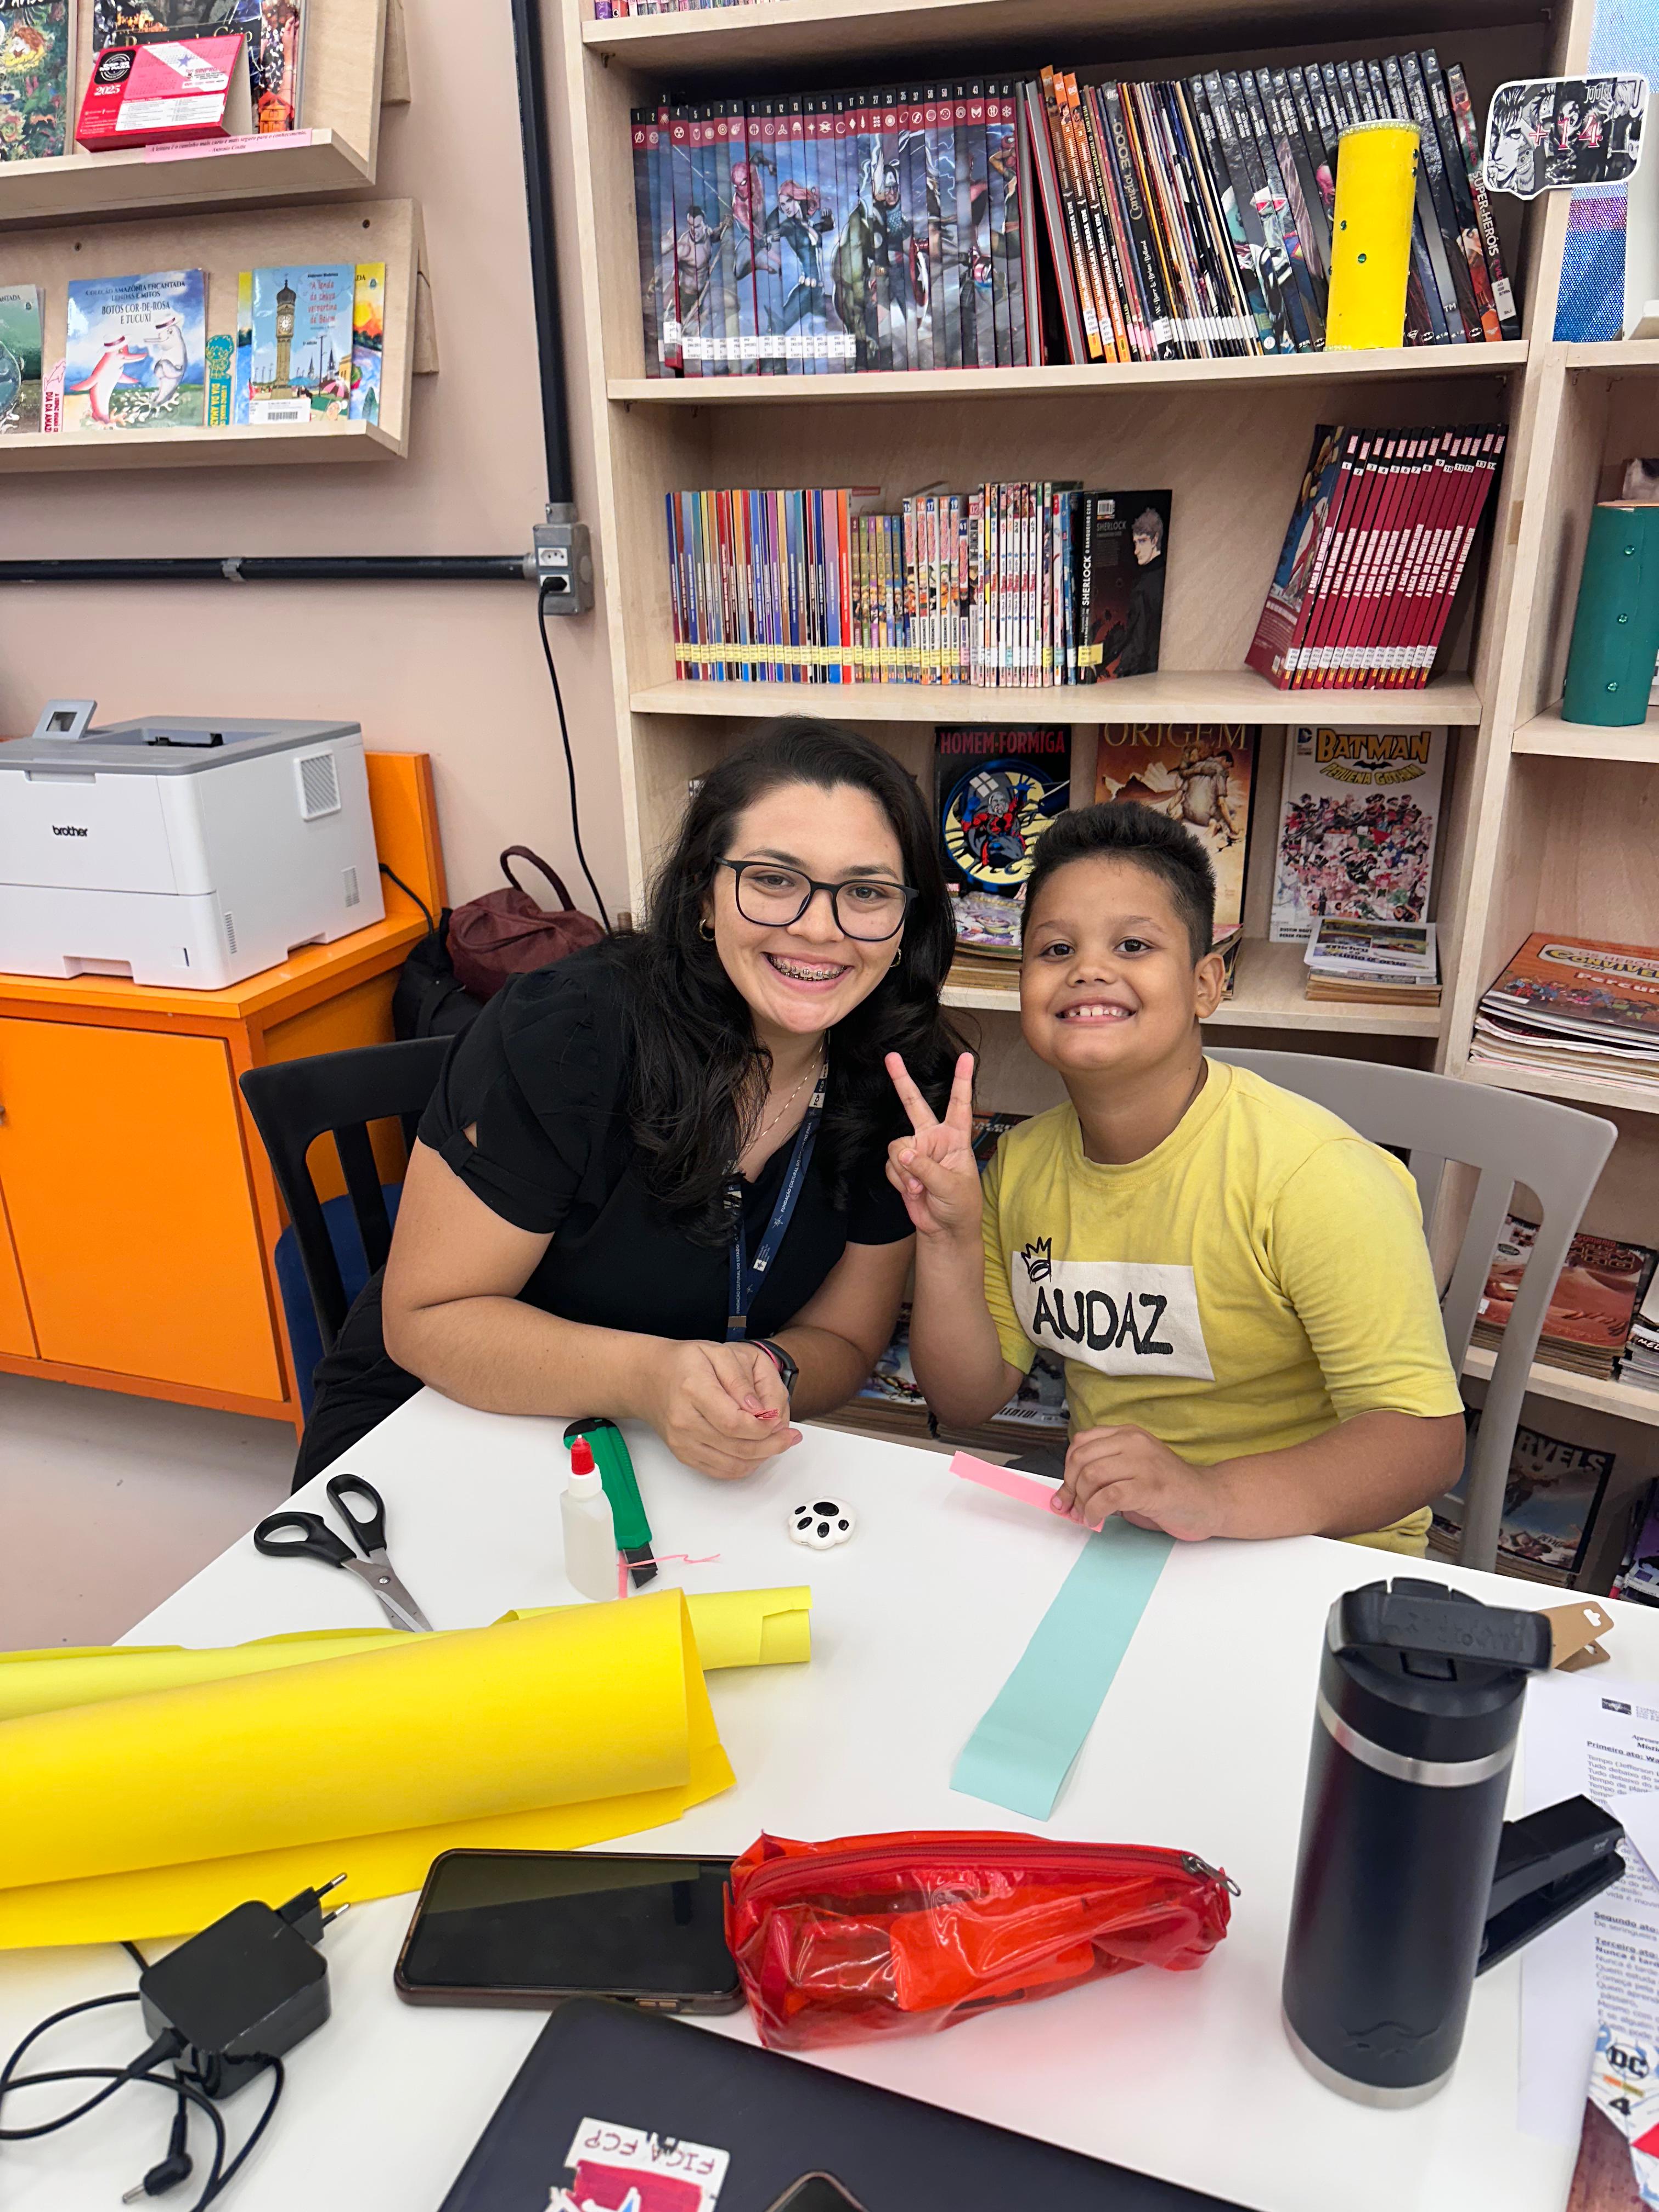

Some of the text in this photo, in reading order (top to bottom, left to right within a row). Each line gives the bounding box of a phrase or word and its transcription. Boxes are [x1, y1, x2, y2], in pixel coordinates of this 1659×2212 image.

[94, 84, 121, 96] 2025
[912, 92, 919, 101] 37
[972, 84, 979, 95] 43
[1002, 84, 1009, 95] 47
[662, 94, 667, 103] 3
[849, 97, 854, 107] 17
[872, 94, 879, 105] 27
[676, 108, 681, 117] 4
[719, 105, 724, 114] 7
[751, 105, 755, 114] 9
[778, 103, 785, 113] 12
[808, 102, 814, 112] 14
[636, 112, 640, 121] 1
[651, 112, 655, 122] 2
[693, 110, 698, 119] 5
[1082, 105, 1092, 132] HELLBOY
[1090, 142, 1101, 177] DESPERTAR
[1112, 120, 1144, 221] Camelot 3000
[1096, 177, 1103, 188] DO
[1093, 212, 1103, 227] UM
[1471, 170, 1499, 256] SUPER-HERÓIS
[1065, 200, 1081, 241] TERRA UM
[1080, 208, 1094, 250] TERRA UM
[1096, 227, 1108, 253] TERRA
[1110, 244, 1118, 261] MIKE
[1113, 261, 1124, 287] MIGNOLA
[114, 284, 146, 293] AMAZÔNIA
[147, 280, 185, 290] ENCANTADA
[102, 301, 170, 315] BOTOS COR-DE-ROSA
[121, 316, 125, 324] E
[211, 384, 221, 406] DIA DA
[46, 404, 53, 413] DA
[927, 501, 934, 511] 17
[951, 499, 957, 510] 19
[970, 505, 978, 514] 02
[960, 523, 967, 532] 41
[1097, 521, 1126, 532] SHERLOCK
[1082, 555, 1091, 606] SHERLOCK
[940, 731, 1065, 755] HOMEM-FORMIGA
[1104, 724, 1248, 750] ORIGEM
[1316, 729, 1431, 763] BATMAN
[1319, 763, 1426, 786] PEQUENA GOTHAM
[52, 825, 88, 838] brother
[1544, 949, 1659, 978] CONVIVE
[780, 1187, 792, 1212] FUNDAÇÃO
[789, 1166, 800, 1188] CULTURAL
[796, 1158, 801, 1167] DO
[1032, 1286, 1173, 1355] AUDAZ
[1516, 1430, 1607, 1475] RVELS
[1587, 1740, 1643, 1760] Primeiro ato:
[1588, 1754, 1654, 1775] Tempo (Jefferson
[1588, 1760, 1651, 1781] Tudo debaixo do
[1588, 1768, 1652, 1788] Tudo debaixo do
[1588, 1774, 1615, 1786] Tempo
[1589, 1781, 1615, 1793] Tempo
[1606, 1891, 1623, 1900] vida
[1594, 1911, 1637, 1928] Segundo
[1595, 1936, 1636, 1954] Terceiro
[1595, 1945, 1627, 1959] Nunca
[1595, 1954, 1624, 1967] Nunca
[1610, 2046, 1648, 2079] DC
[1609, 2097, 1632, 2116] 4
[584, 2129, 639, 2157] FCP
